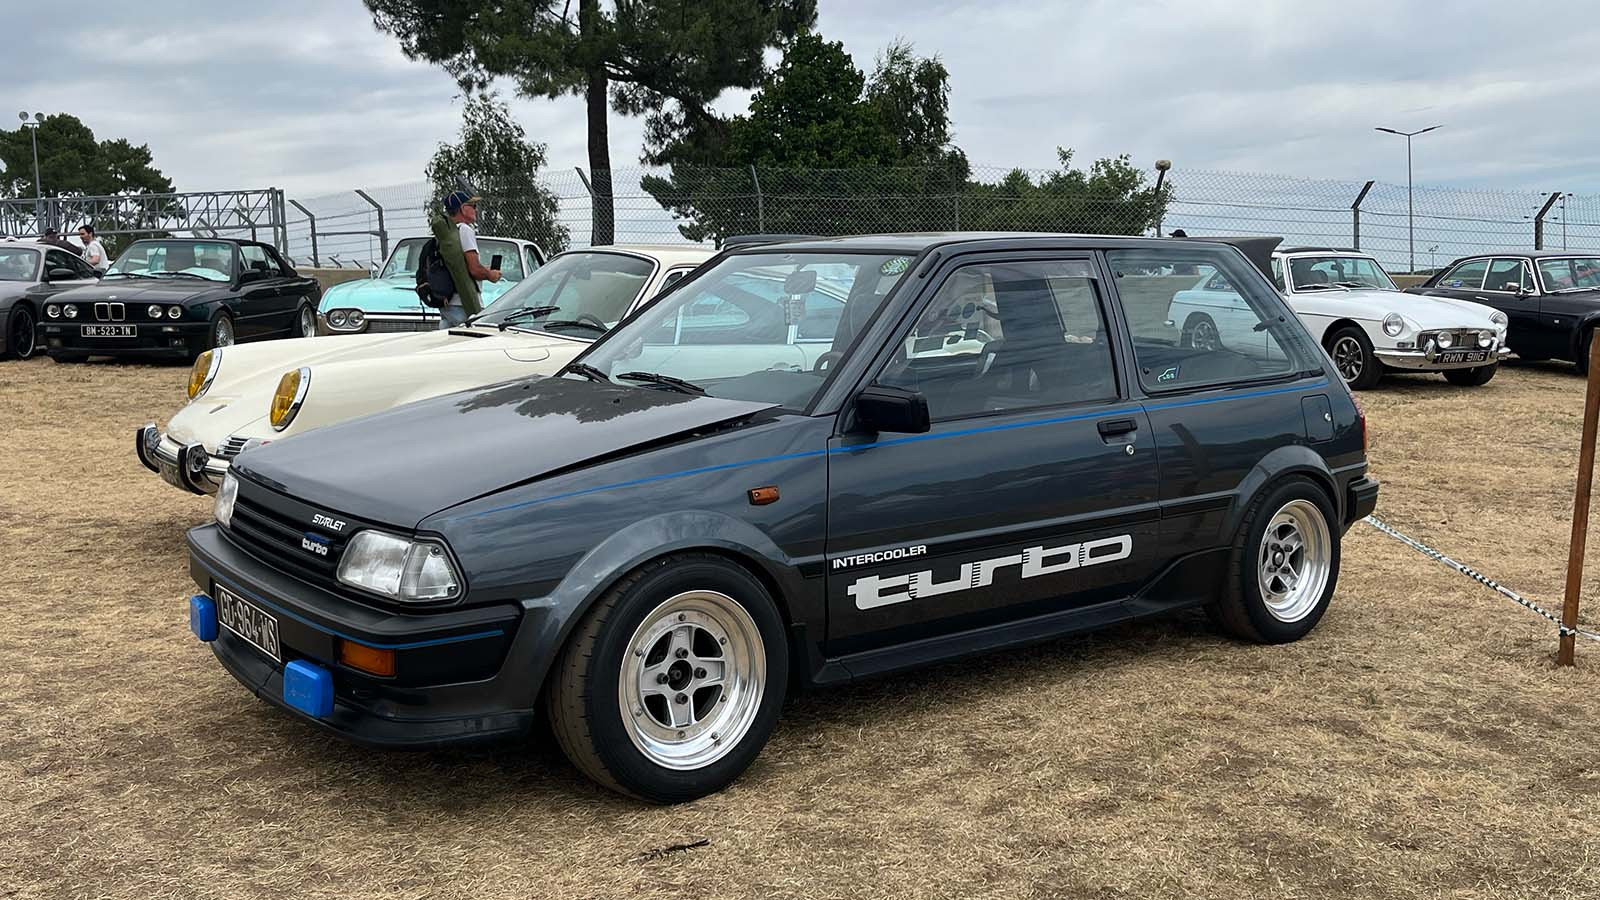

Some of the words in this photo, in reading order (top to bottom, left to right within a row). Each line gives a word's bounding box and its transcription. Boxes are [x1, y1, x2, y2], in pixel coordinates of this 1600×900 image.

[1442, 352, 1464, 363] RWN
[1465, 352, 1485, 362] 911G
[312, 513, 346, 531] STARLET
[302, 537, 328, 556] turbo
[832, 544, 927, 569] INTERCOOLER
[847, 534, 1133, 611] turbo
